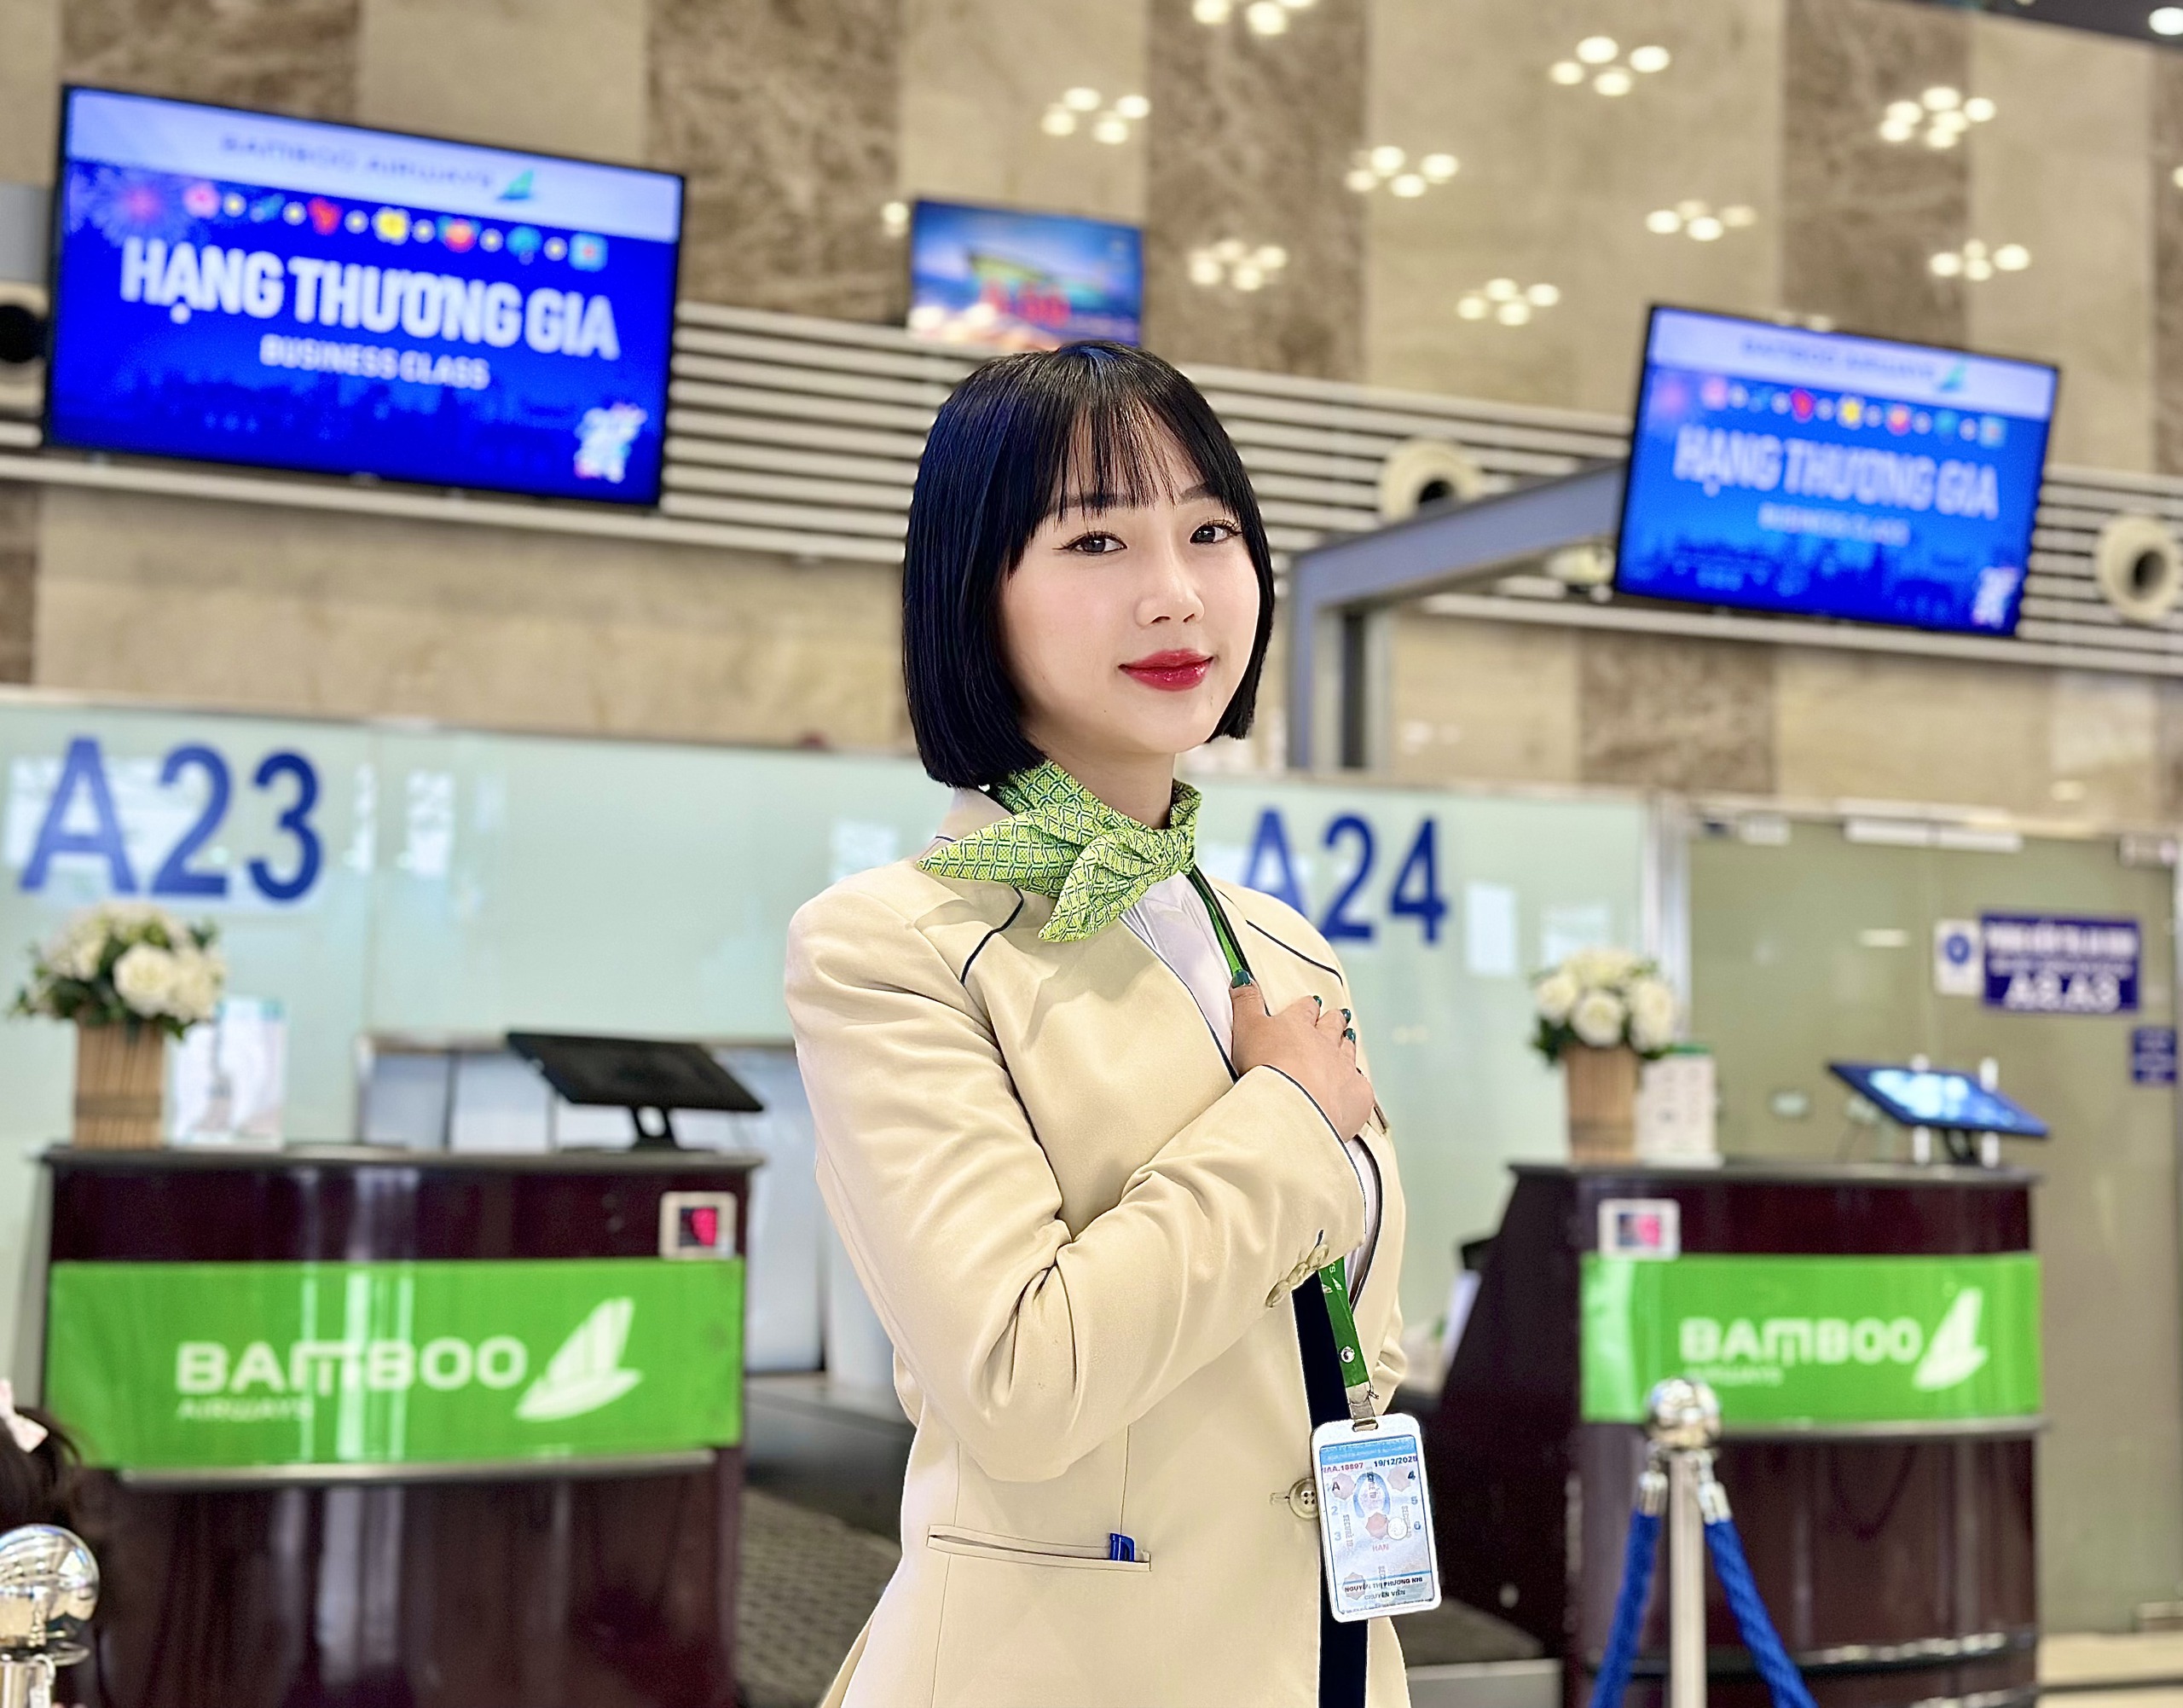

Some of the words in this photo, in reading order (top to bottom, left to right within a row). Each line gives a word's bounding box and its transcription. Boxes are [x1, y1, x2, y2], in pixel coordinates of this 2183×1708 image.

[119, 236, 285, 325] HẠNG
[287, 256, 522, 348] THƯƠNG
[525, 287, 622, 362] GIA
[260, 333, 400, 379] BUSINESS
[399, 349, 491, 391] CLASS
[19, 735, 322, 902] A23
[1242, 806, 1449, 945] A24
[176, 1335, 528, 1397] BAMBOO
[1678, 1317, 1924, 1368] BAMBOO
[1331, 1506, 1338, 1515] 2
[1332, 1482, 1340, 1491] A
[1335, 1531, 1341, 1541] 3
